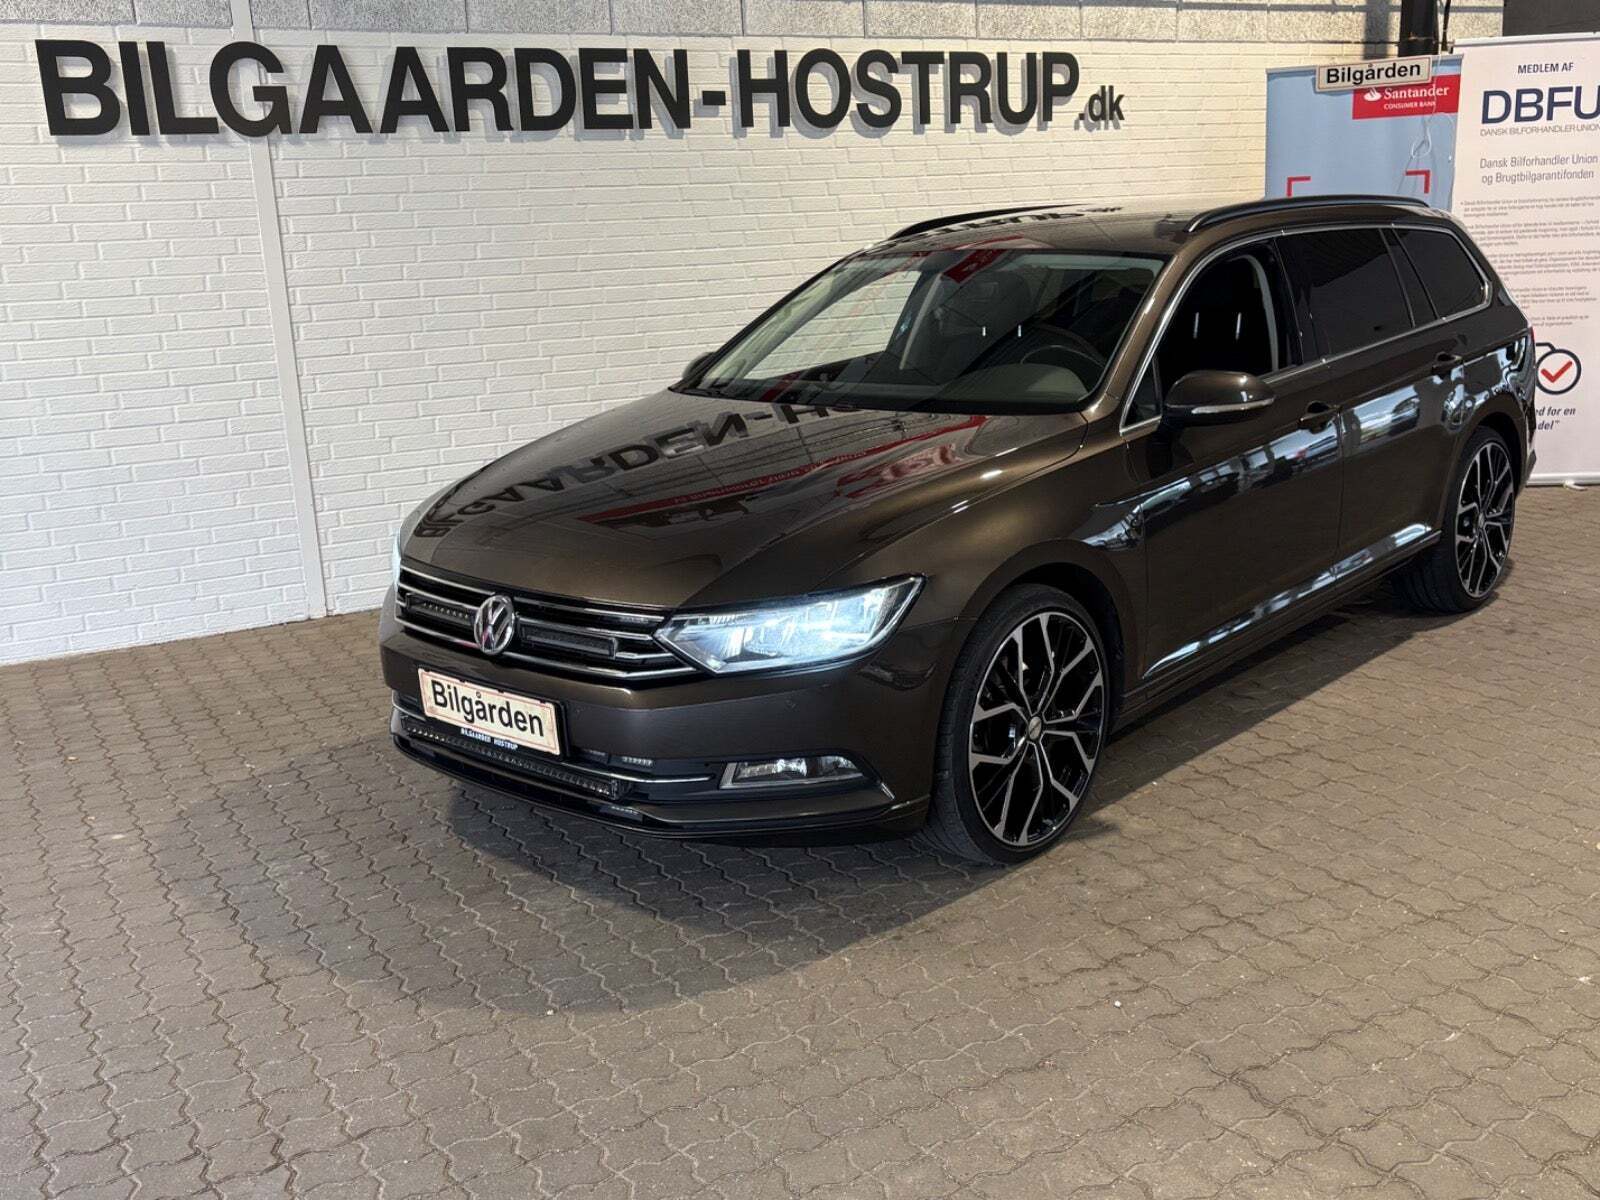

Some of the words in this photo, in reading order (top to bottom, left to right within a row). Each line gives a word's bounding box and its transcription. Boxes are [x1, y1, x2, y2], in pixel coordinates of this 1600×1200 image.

[1327, 61, 1421, 85] Bilgården
[1517, 63, 1559, 74] MEDLEM
[1561, 62, 1574, 72] AF
[1383, 84, 1450, 100] Santander
[1383, 102, 1418, 111] CONSUMER
[1481, 85, 1600, 125] DBFU
[1480, 128, 1508, 137] DANSK
[1509, 124, 1575, 136] BILFORHANDLER
[1480, 157, 1508, 169] Dansk
[1510, 154, 1570, 167] Bilforhandler
[1571, 154, 1598, 165] Union
[1481, 177, 1493, 185] og
[1495, 169, 1594, 185] Brugtbilgarantifonden
[1547, 406, 1561, 416] for
[432, 680, 545, 737] Bilgården
